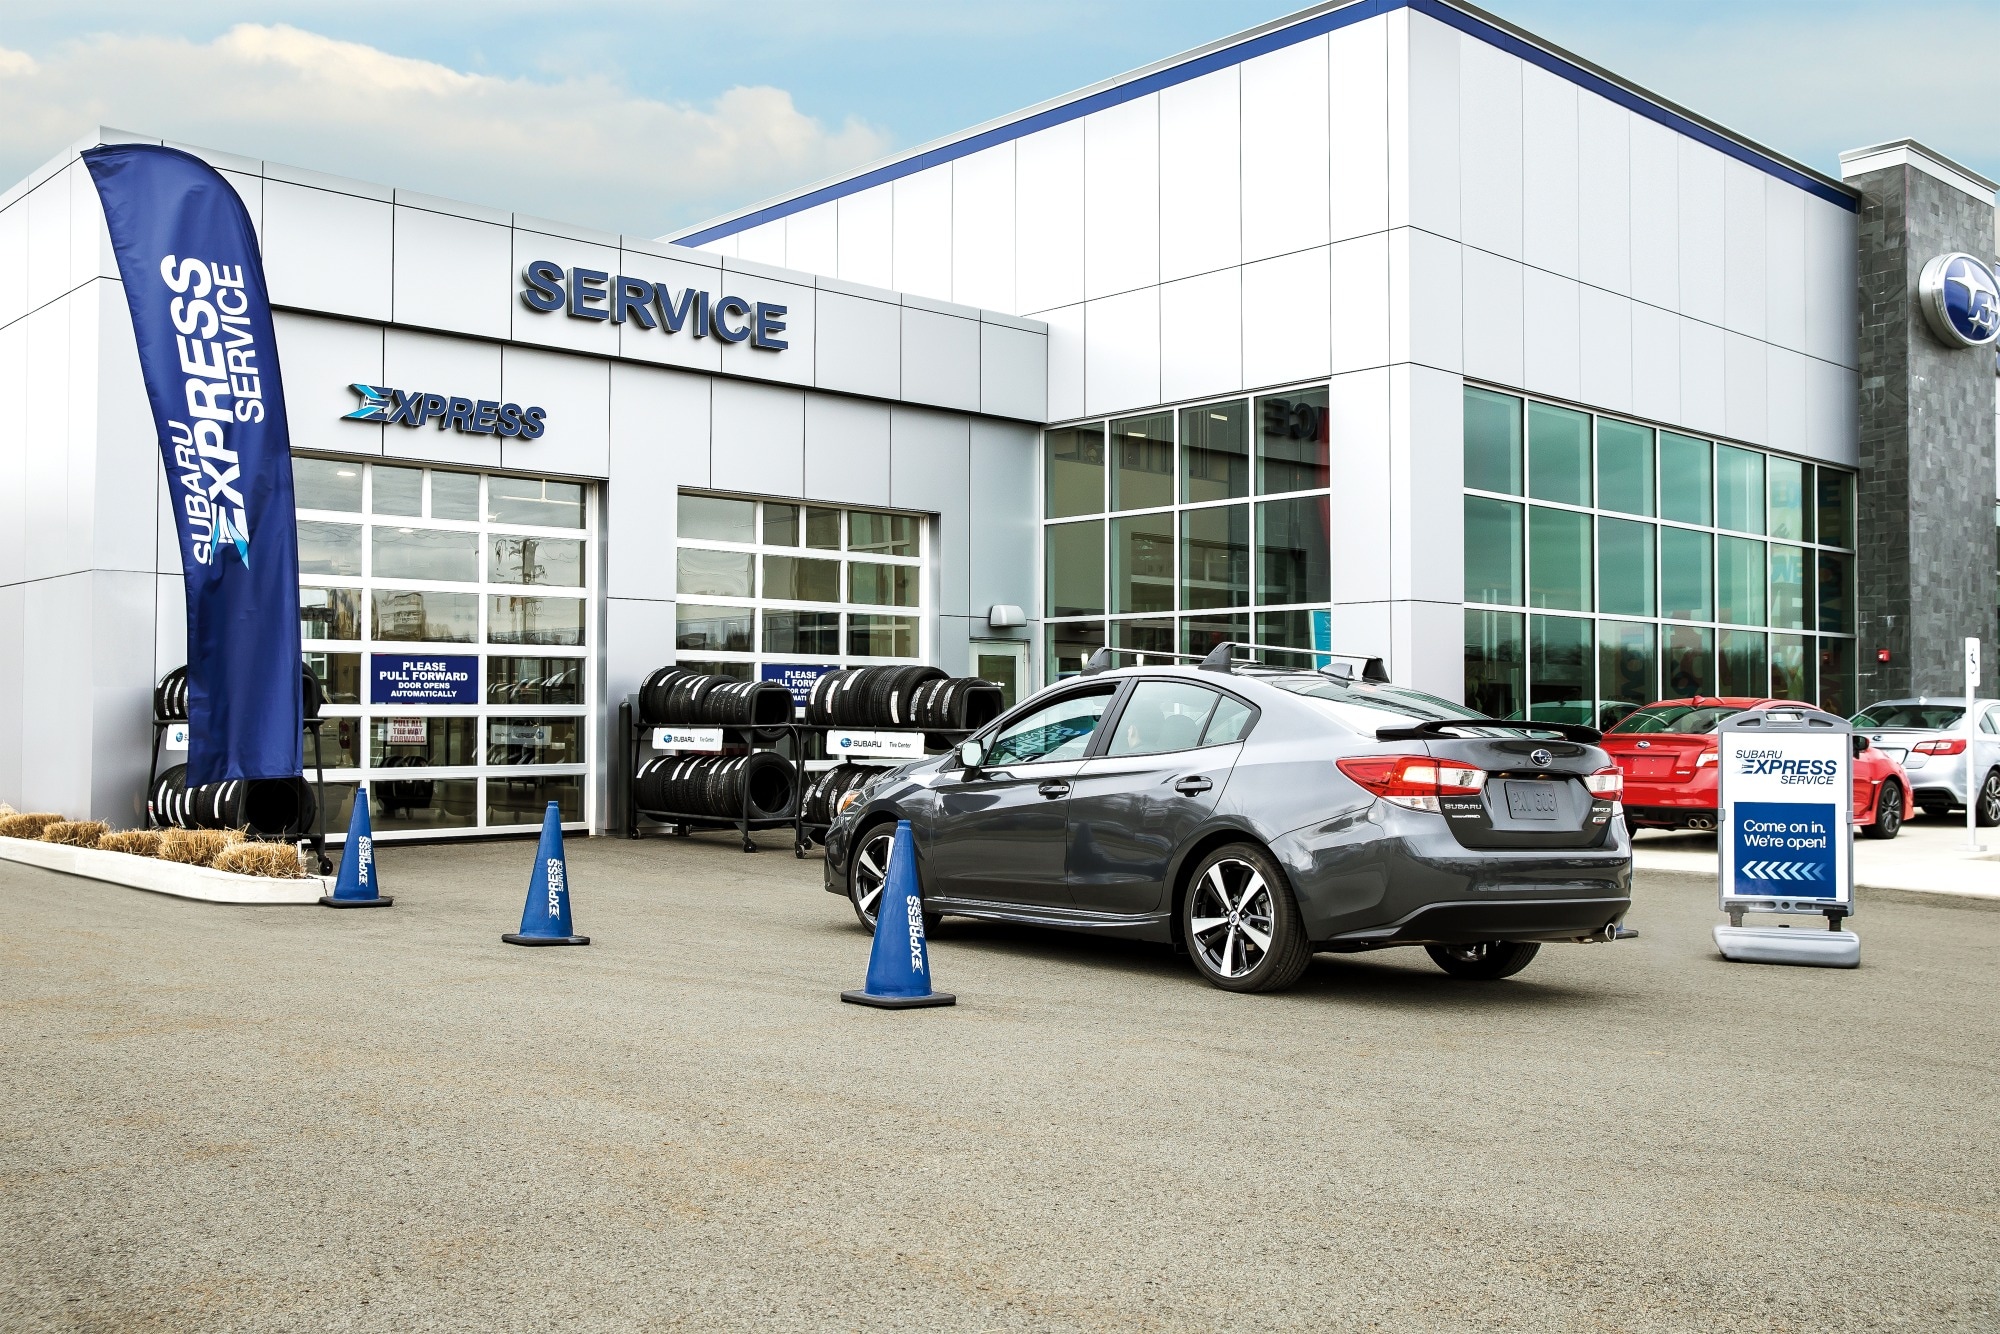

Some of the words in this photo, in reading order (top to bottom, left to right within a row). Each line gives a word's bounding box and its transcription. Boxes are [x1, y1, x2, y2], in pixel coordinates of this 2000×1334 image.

[520, 259, 789, 351] SERVICE
[211, 261, 265, 424] SERVICE
[160, 254, 250, 570] EXPRESS
[340, 383, 548, 440] EXPRESS
[167, 420, 212, 566] SUBARU
[402, 661, 447, 671] PLEASE
[379, 671, 410, 681] PULL
[412, 672, 468, 681] FORWARD
[784, 670, 817, 679] PLEASE
[792, 679, 816, 687] FORW
[390, 690, 457, 698] AUTOMATICALLY
[853, 740, 882, 748] SUBARU
[1735, 750, 1783, 759] SUBARU
[1735, 759, 1838, 775] EXPRESS
[1780, 775, 1835, 785] SERVICE
[1743, 819, 1787, 833] Come
[1789, 823, 1808, 833] on
[1811, 821, 1826, 834] in.
[1743, 834, 1784, 848] We're
[1786, 836, 1827, 851] open!
[358, 836, 368, 888] EXPRESS
[547, 858, 560, 921] EXPRESS
[906, 895, 924, 975] EXPRESS
